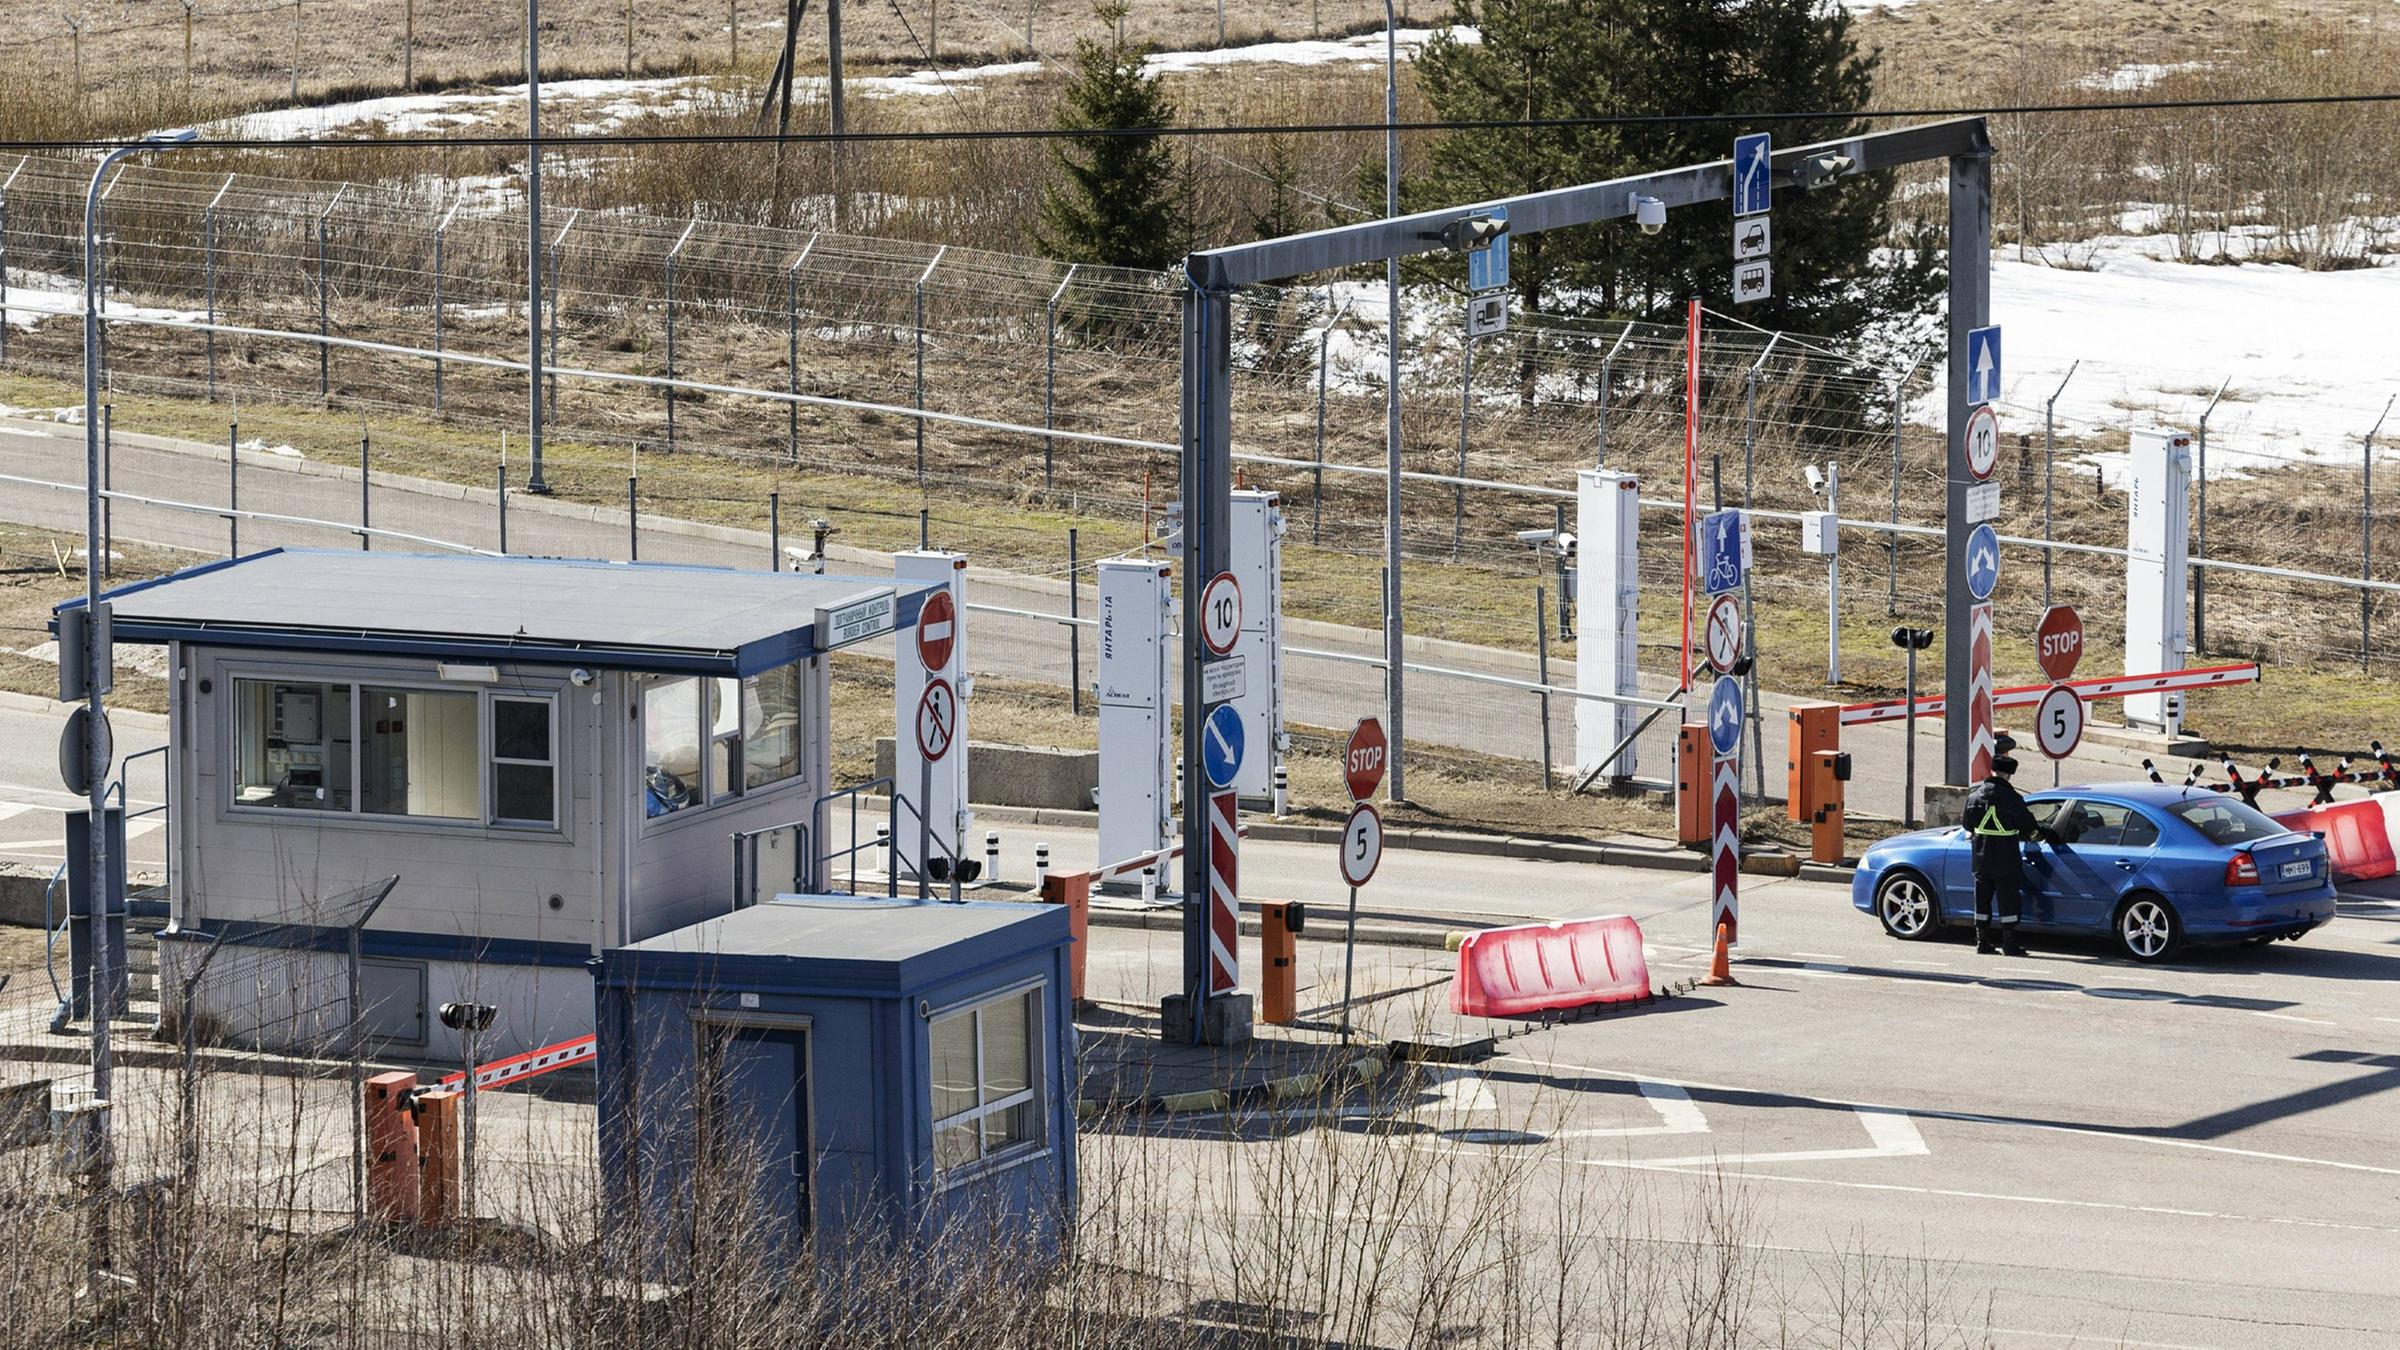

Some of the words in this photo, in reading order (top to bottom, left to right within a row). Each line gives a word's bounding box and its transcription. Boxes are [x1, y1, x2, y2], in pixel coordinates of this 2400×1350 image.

[1975, 429, 1991, 458] 10
[1104, 595, 1113, 660] ЯНТАРЬ-1А
[1214, 597, 1233, 630] 10
[843, 624, 860, 639] BORDER
[862, 618, 880, 633] CONTROL
[2043, 630, 2079, 656] STOP
[2053, 709, 2066, 739] 5
[1350, 746, 1382, 773] STOP
[1356, 827, 1367, 861] 5
